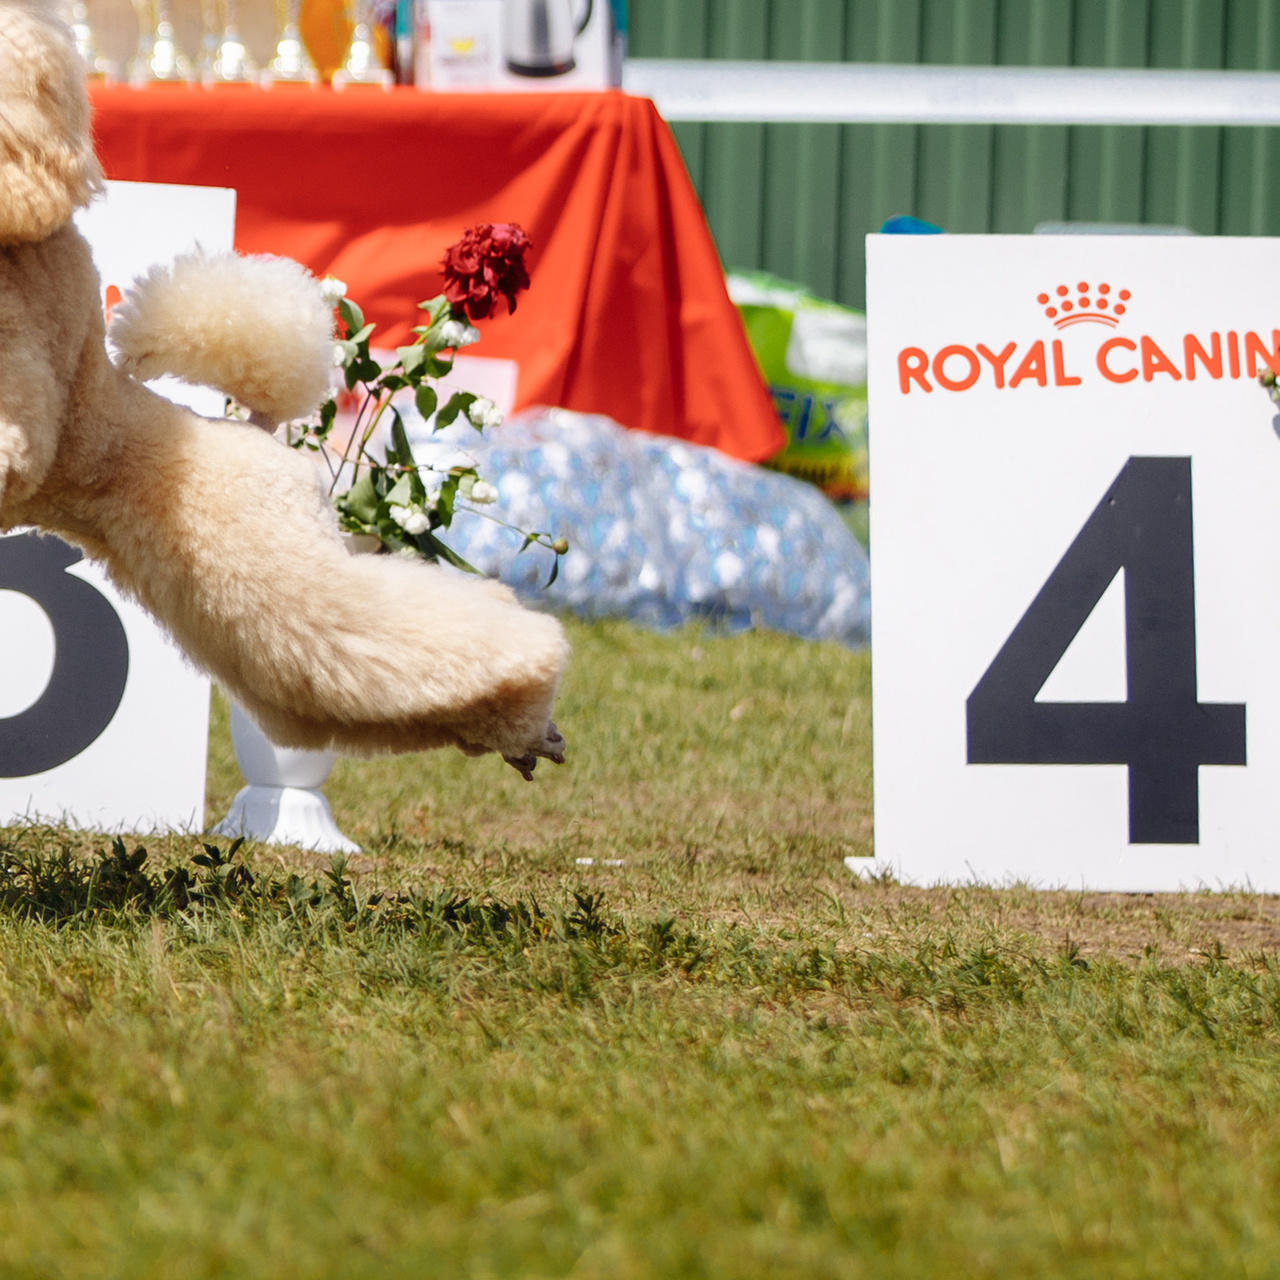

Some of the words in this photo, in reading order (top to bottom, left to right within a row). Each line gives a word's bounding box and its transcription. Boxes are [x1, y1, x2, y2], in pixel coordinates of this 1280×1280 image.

[897, 339, 1082, 395] ROYAL
[1096, 329, 1280, 385] CANIN
[966, 456, 1246, 845] 4
